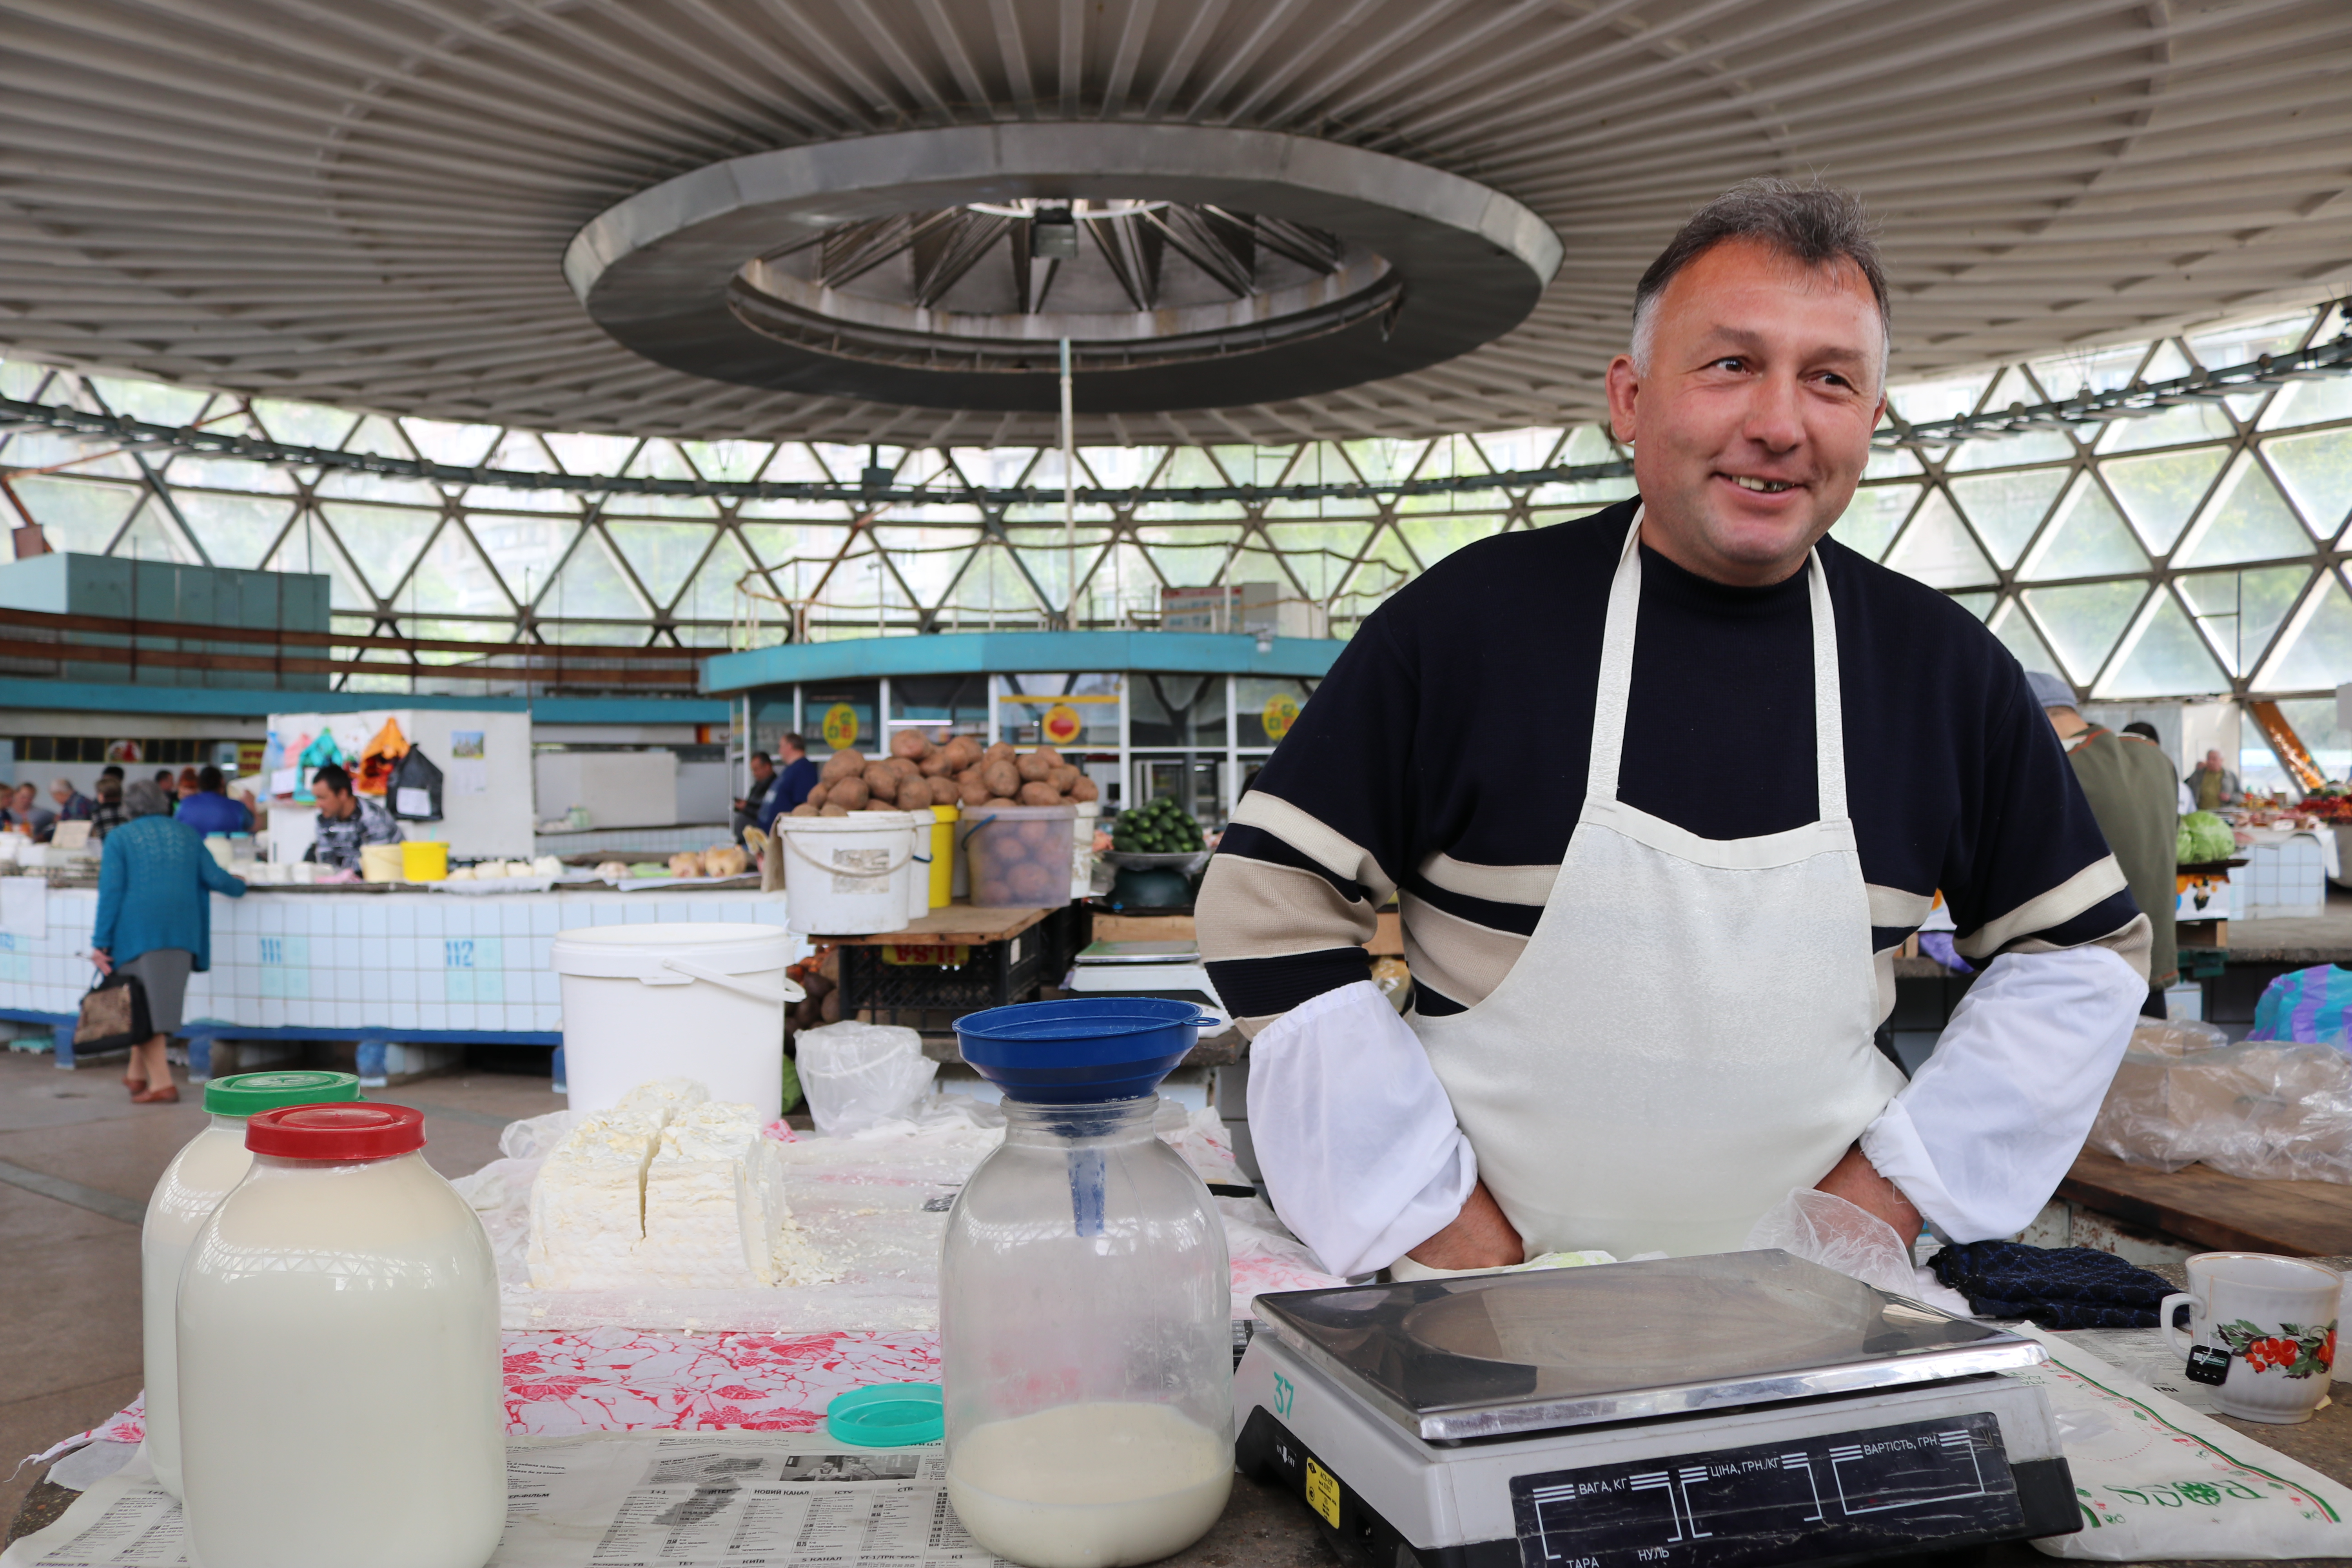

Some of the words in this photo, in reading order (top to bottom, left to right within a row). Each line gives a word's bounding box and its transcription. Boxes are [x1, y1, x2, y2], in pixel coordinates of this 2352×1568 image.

[445, 940, 474, 967] 112
[1274, 1371, 1294, 1420] 37
[1864, 1439, 1916, 1455] ВАРТІСТЬ,
[1917, 1436, 1941, 1447] ГРН.
[1710, 1463, 1741, 1478] ЦІНА,
[1742, 1457, 1780, 1473] ГРН./КГ
[1579, 1481, 1612, 1495] ВАГА,
[1613, 1477, 1627, 1490] КГ
[1566, 1557, 1600, 1568] ТАРА
[1638, 1546, 1670, 1561] НУЛЬ
